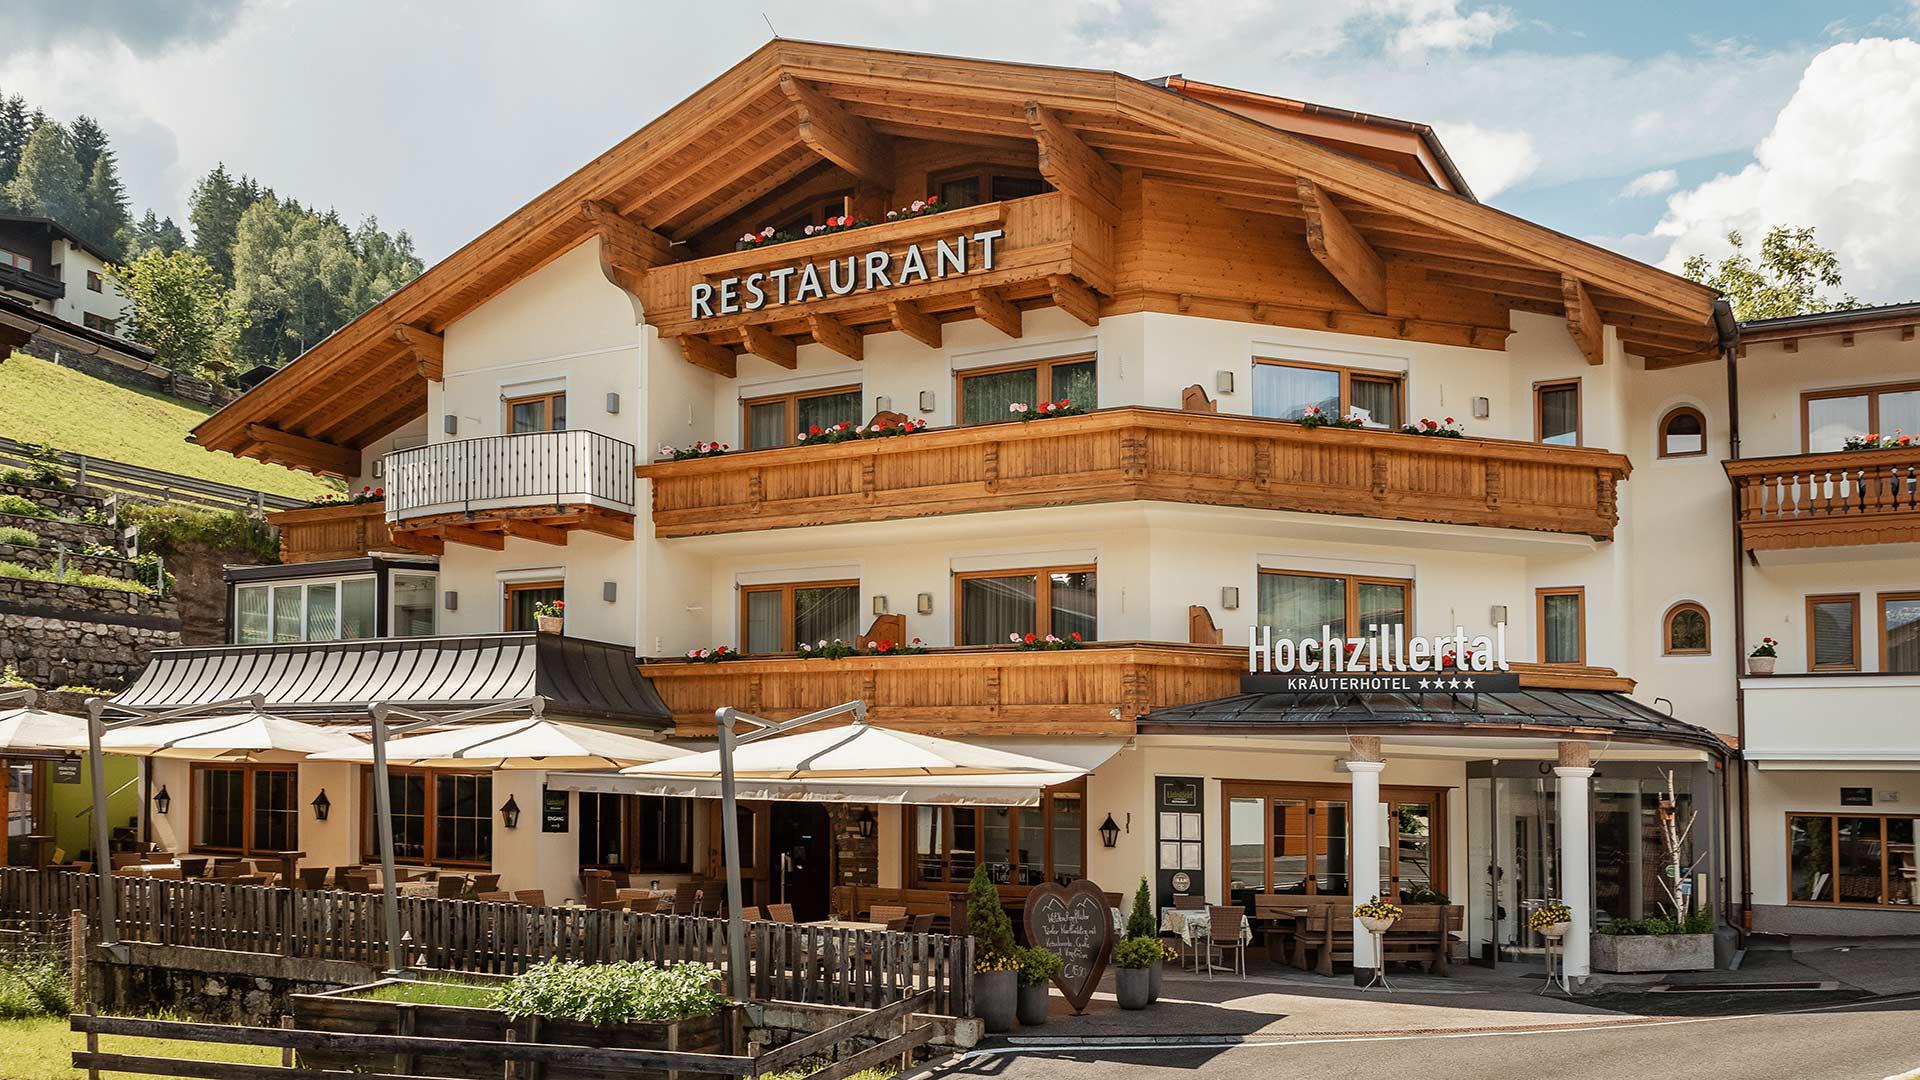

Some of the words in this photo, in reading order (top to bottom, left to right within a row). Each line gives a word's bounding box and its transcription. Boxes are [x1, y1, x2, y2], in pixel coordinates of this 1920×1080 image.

[691, 229, 1002, 319] RESTAURANT
[1249, 622, 1510, 673] Hochzillertal
[1288, 675, 1411, 690] KRÄUTERHOTEL
